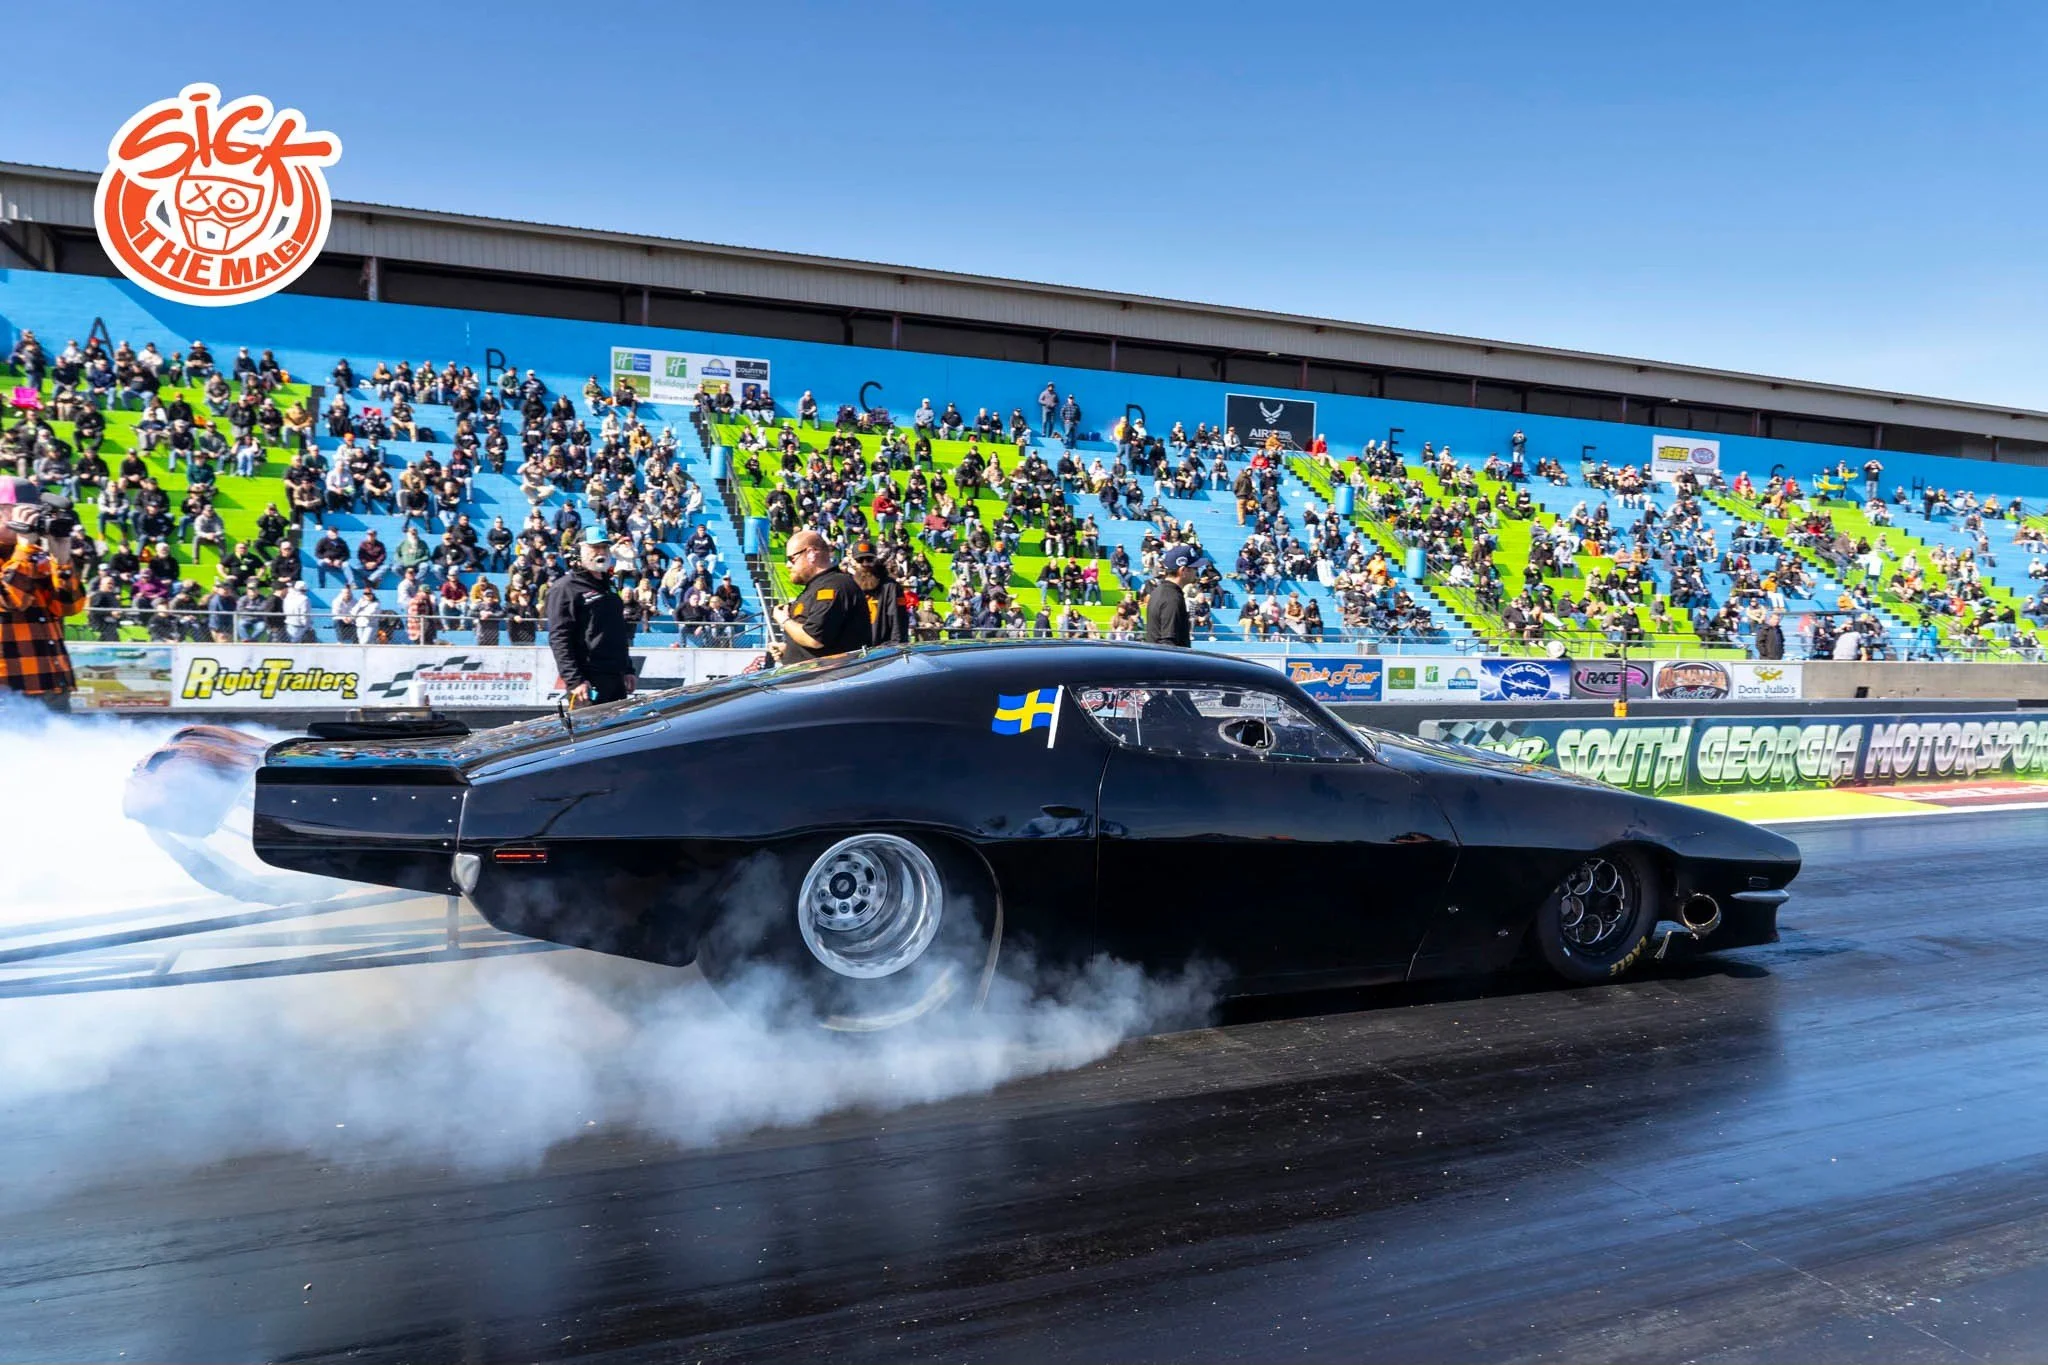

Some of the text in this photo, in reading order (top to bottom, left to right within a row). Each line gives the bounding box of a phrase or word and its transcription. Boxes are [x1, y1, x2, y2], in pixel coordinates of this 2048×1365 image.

[85, 316, 115, 359] A
[485, 347, 507, 387] B
[1249, 428, 1268, 438] AIR
[1388, 427, 1405, 458] E
[1288, 662, 1380, 687] Trick Flow
[1506, 665, 1547, 678] First Coast
[1738, 684, 1796, 694] Don Julio's
[1556, 726, 1692, 790] SOUTH
[1697, 724, 1864, 786] GEORGIA
